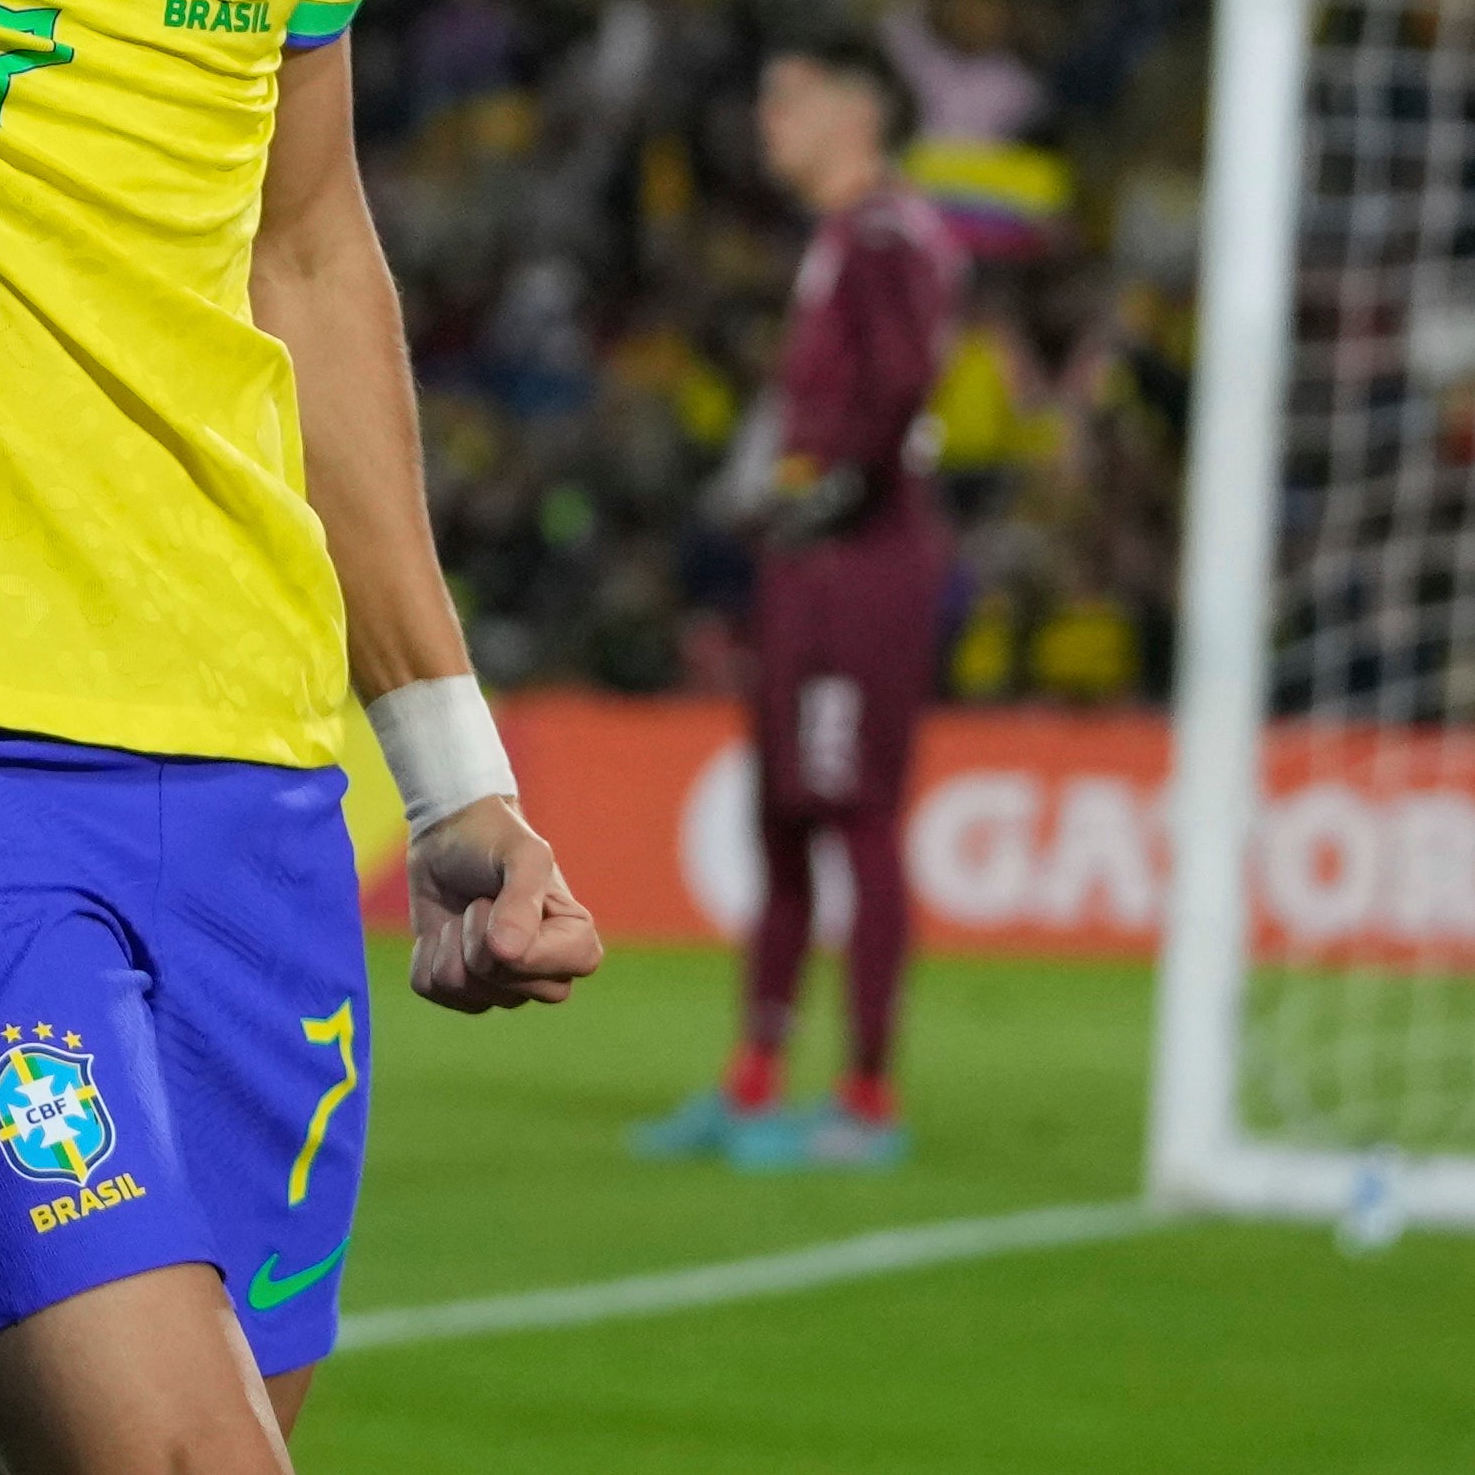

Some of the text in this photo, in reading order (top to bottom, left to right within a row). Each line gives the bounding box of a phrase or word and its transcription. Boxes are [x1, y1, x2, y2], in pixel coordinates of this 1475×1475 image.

[25, 1097, 67, 1125] CBF
[287, 998, 357, 1207] 7
[29, 1172, 147, 1234] BRASIL
